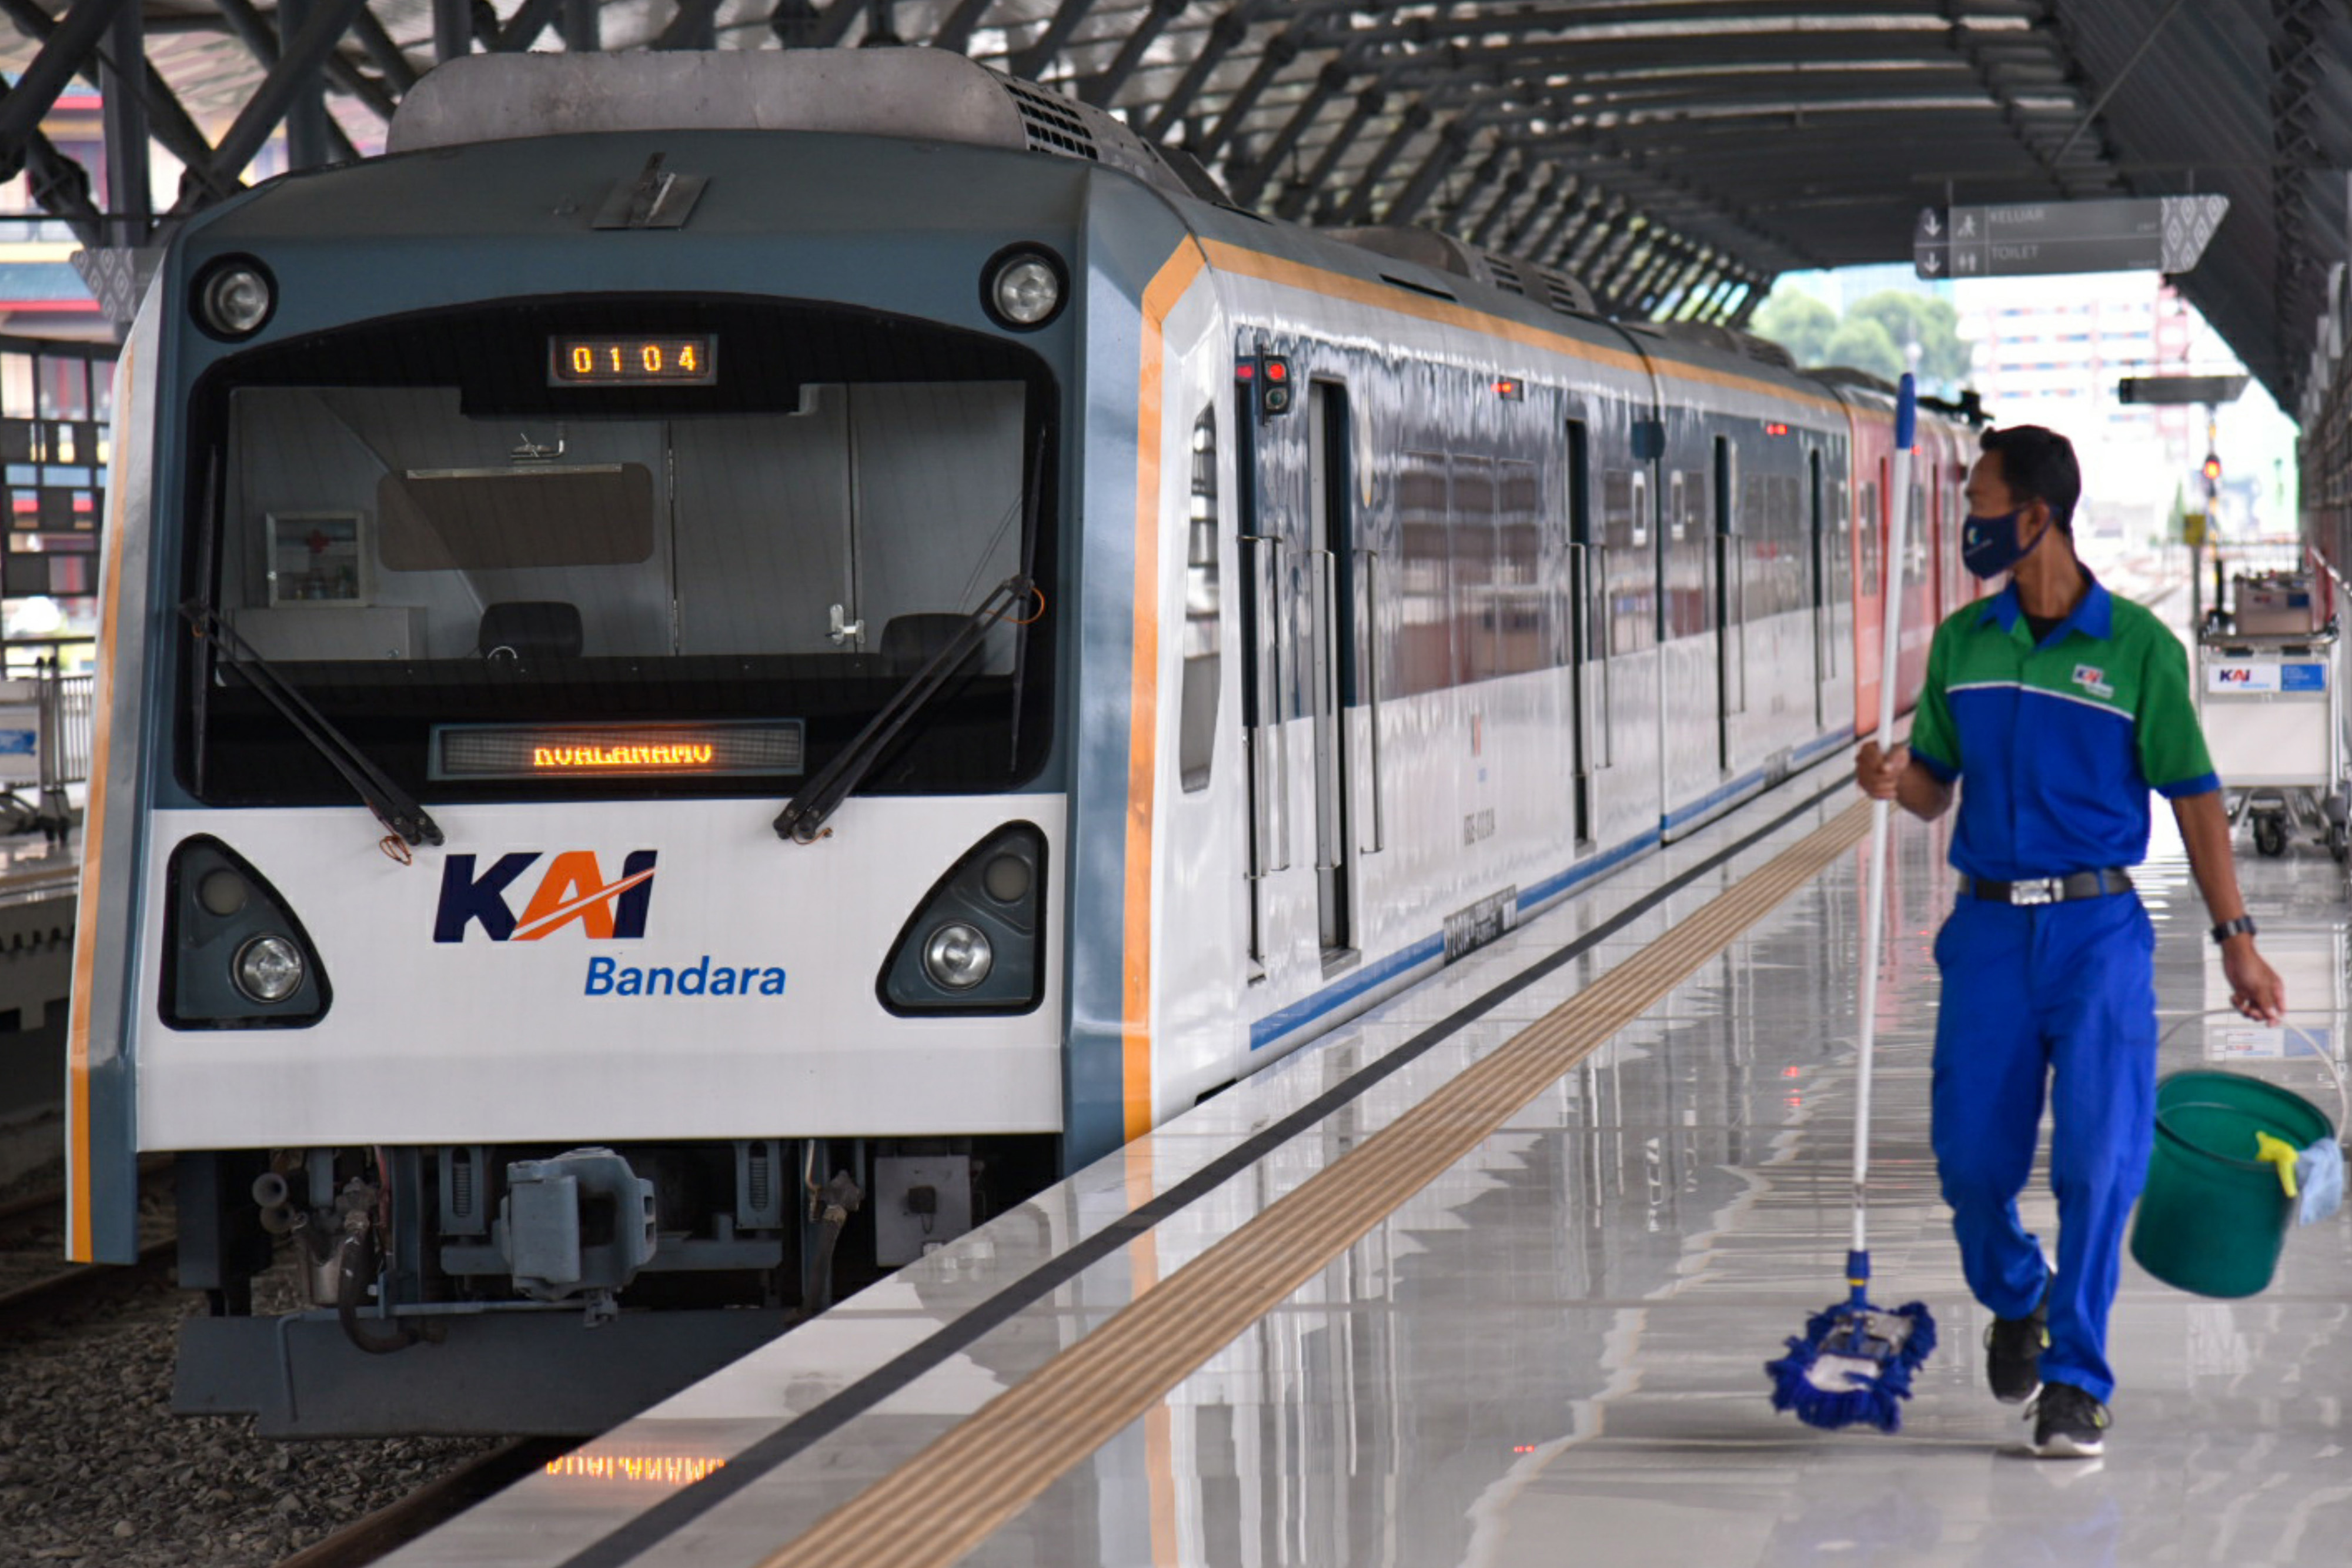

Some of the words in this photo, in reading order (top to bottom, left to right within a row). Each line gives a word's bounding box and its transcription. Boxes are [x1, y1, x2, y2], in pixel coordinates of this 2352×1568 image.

[1991, 244, 2039, 260] TOILET
[2219, 669, 2251, 683] KAI
[433, 850, 658, 943] KAI
[584, 955, 787, 997] Bandara
